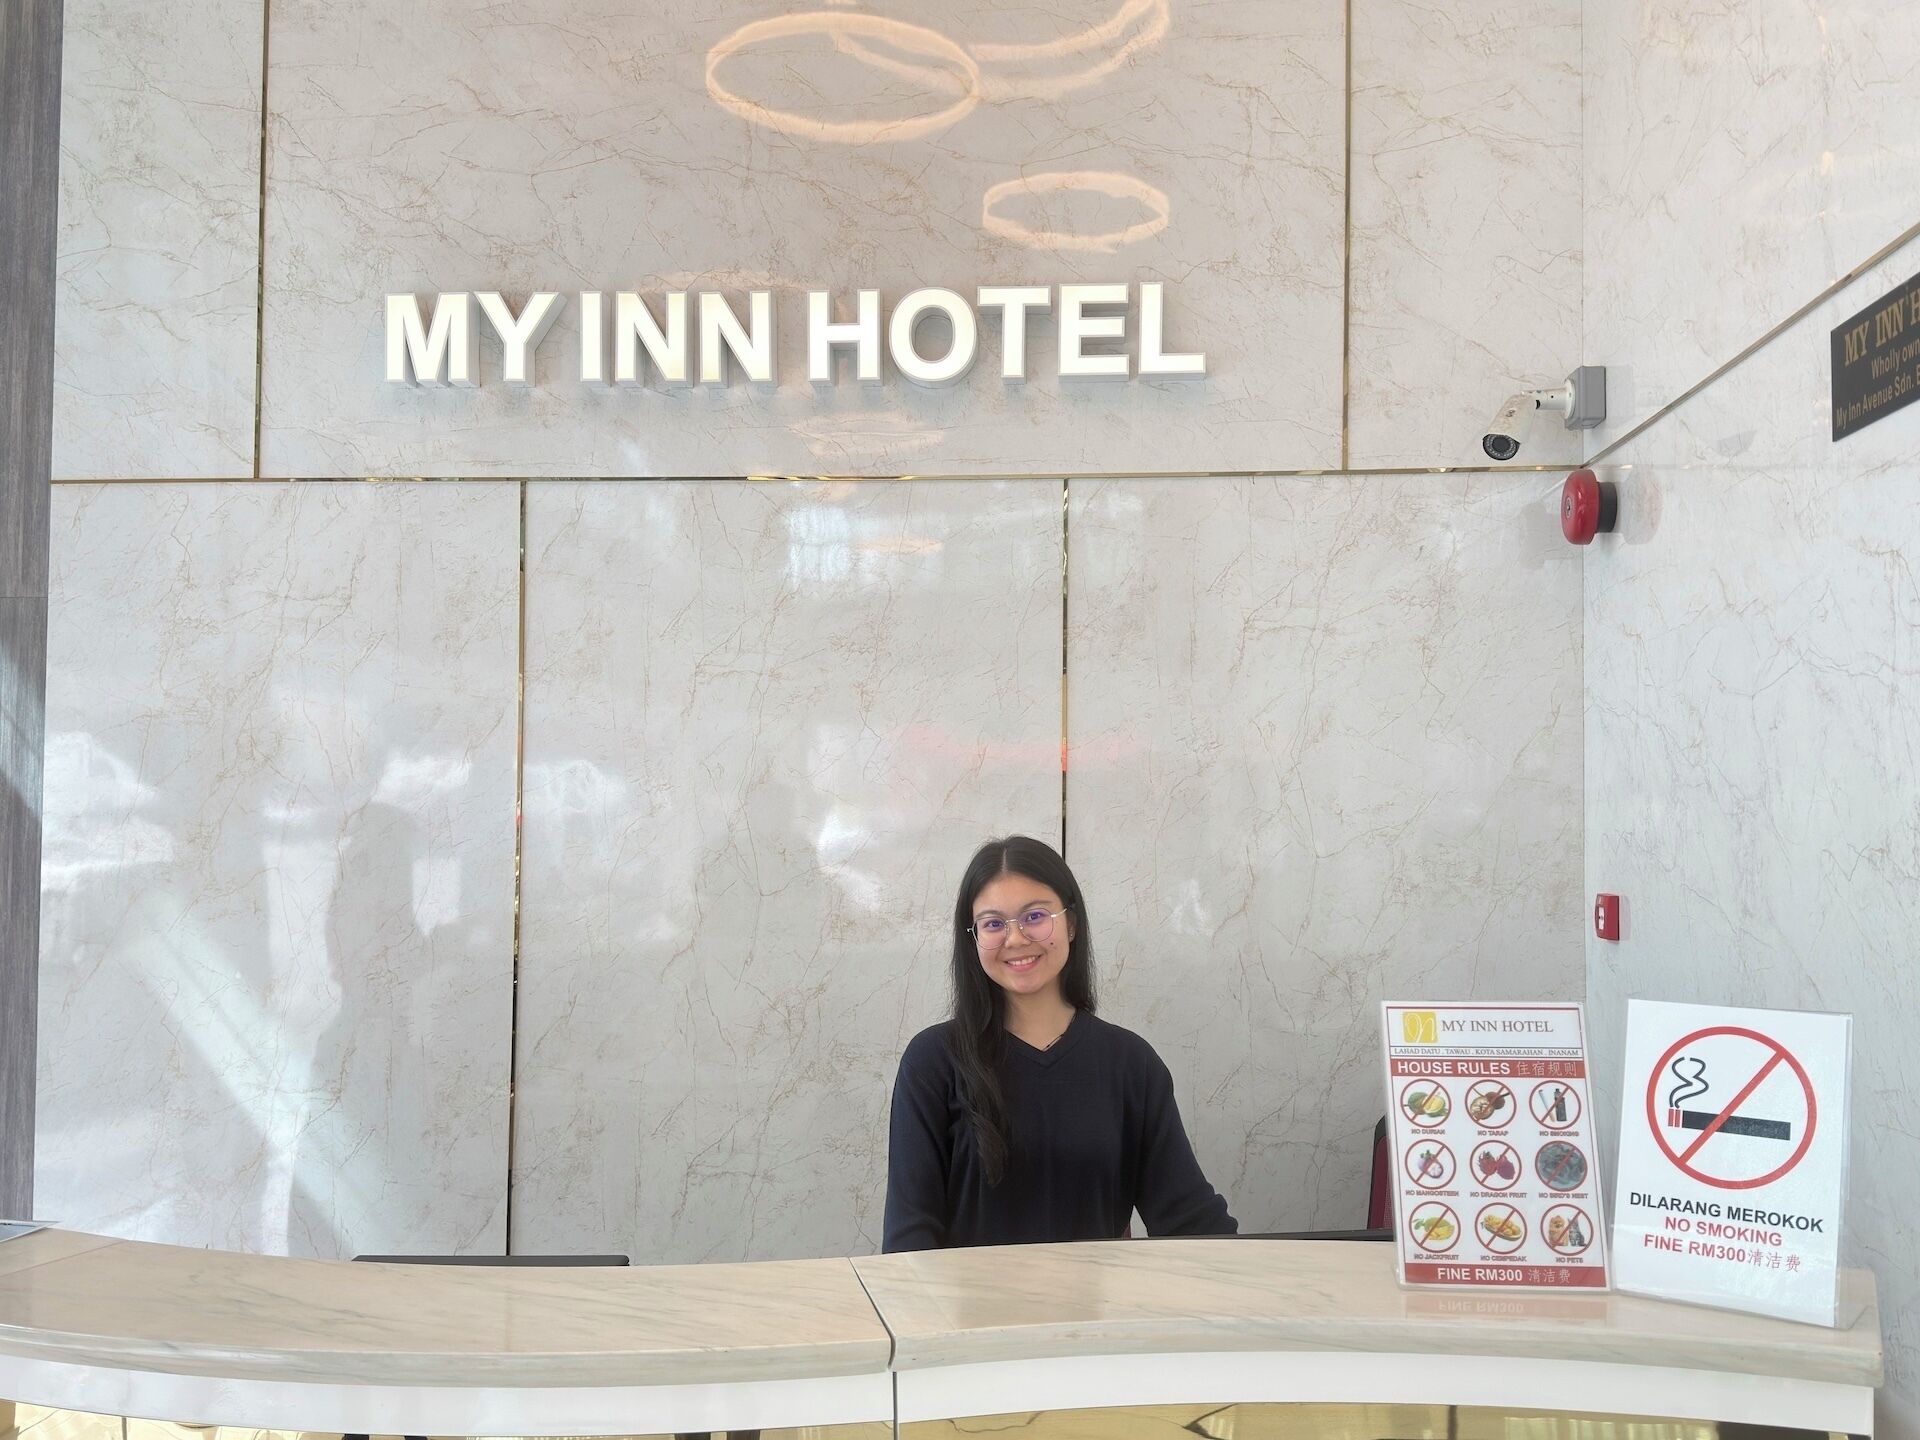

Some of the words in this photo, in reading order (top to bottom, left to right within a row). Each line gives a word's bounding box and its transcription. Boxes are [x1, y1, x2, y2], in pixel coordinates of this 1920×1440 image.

[385, 291, 565, 385] MY
[579, 290, 776, 385] INN
[807, 282, 1206, 386] HOTEL
[1844, 320, 1870, 369] MY
[1875, 298, 1905, 348] INN
[1871, 348, 1901, 380] Wholly
[1836, 407, 1848, 431] My
[1848, 401, 1861, 423] Inn
[1862, 384, 1893, 415] Avenue
[1894, 372, 1915, 398] Sdn.
[1442, 1020, 1466, 1033] MY
[1470, 1020, 1498, 1033] INN
[1502, 1020, 1554, 1033] HOTEL
[1394, 1047, 1420, 1055] LAHAD
[1421, 1048, 1441, 1056] DATU
[1444, 1048, 1471, 1056] TAWAU
[1475, 1049, 1496, 1057] KOTA
[1496, 1049, 1543, 1057] SAMARAHAN
[1397, 1061, 1453, 1074] HOUSE
[1457, 1061, 1510, 1075] RULES
[1516, 1060, 1577, 1077] 住宿规则
[1629, 1192, 1721, 1217] DILARANG
[1726, 1206, 1824, 1233] MEROKOK
[1643, 1233, 1683, 1252] FINE
[1664, 1216, 1691, 1233] NO
[1696, 1221, 1783, 1247] SMOKING
[1437, 1267, 1471, 1280] FINE
[1475, 1268, 1523, 1281] RM300
[1528, 1267, 1571, 1283] 清洁费
